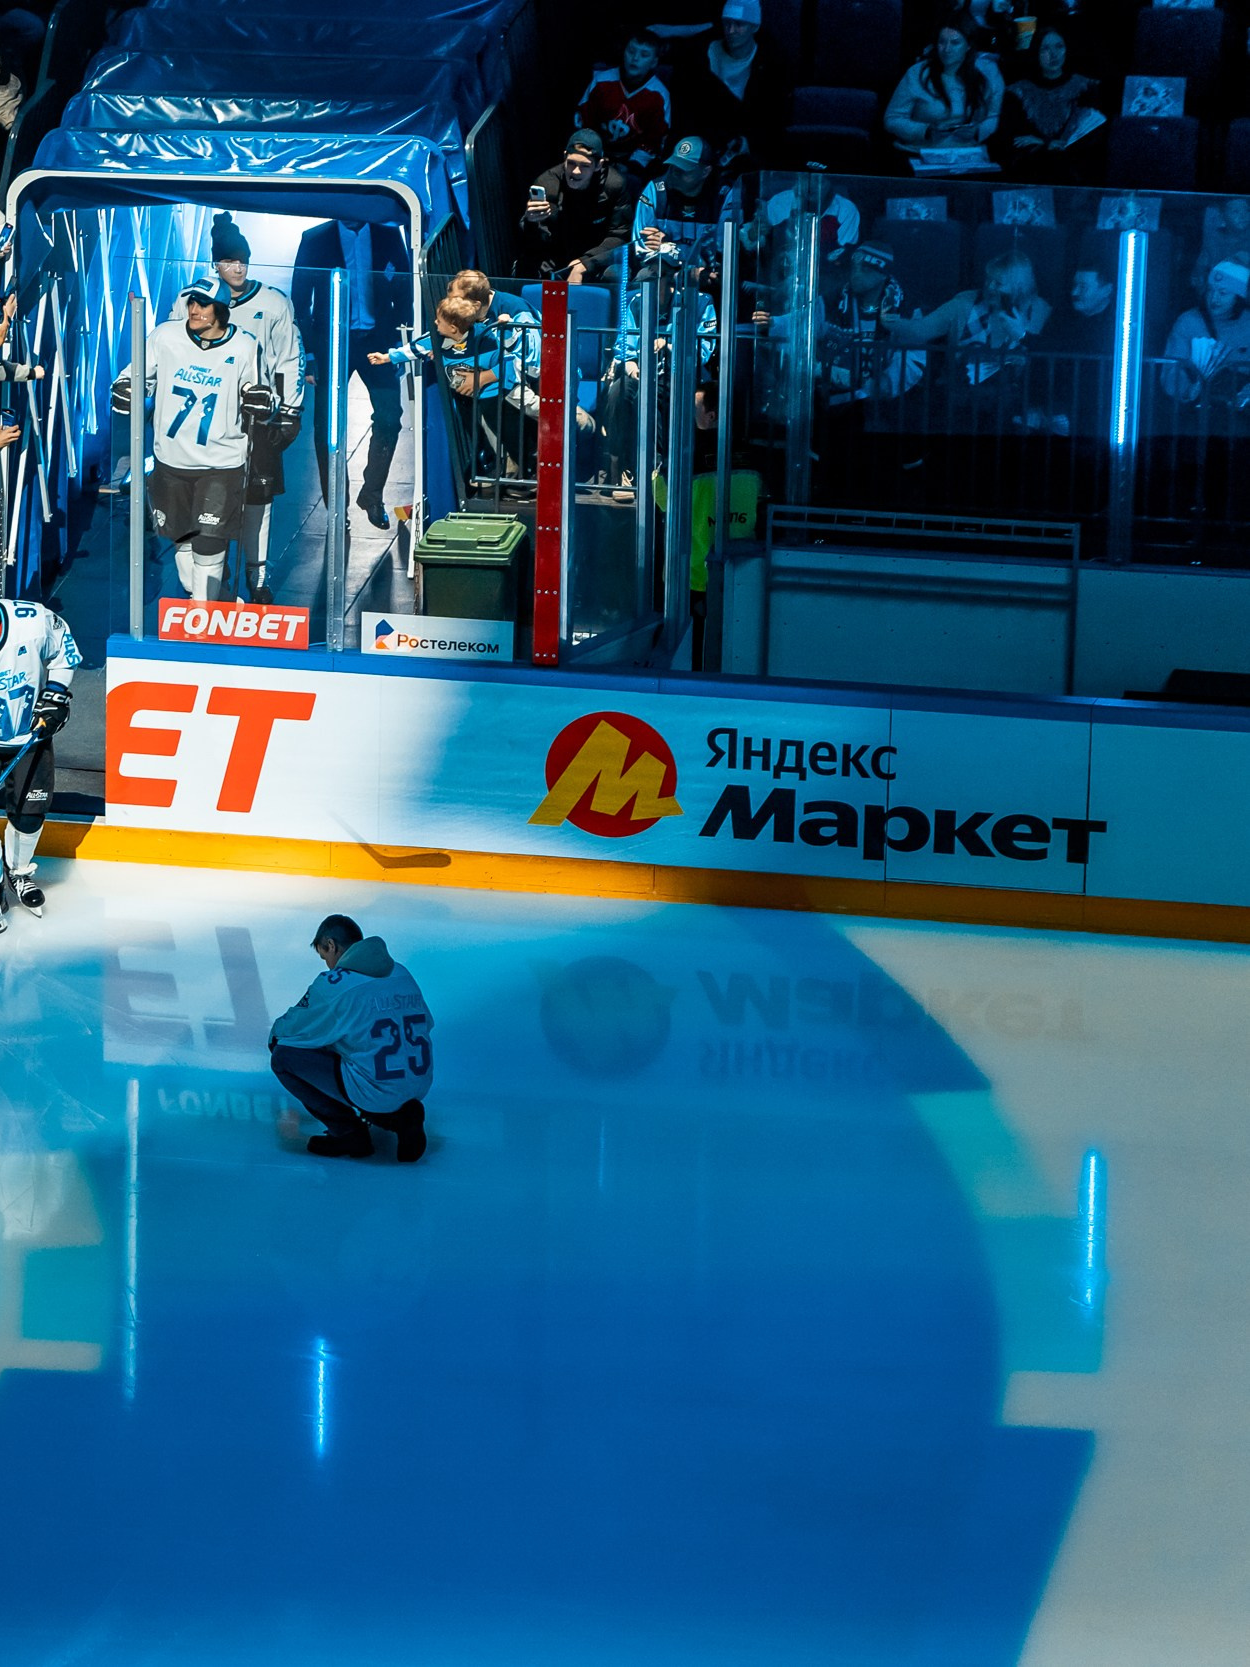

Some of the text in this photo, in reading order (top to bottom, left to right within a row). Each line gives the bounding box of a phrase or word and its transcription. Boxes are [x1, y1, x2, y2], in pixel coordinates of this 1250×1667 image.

[166, 385, 219, 447] 71
[161, 606, 306, 641] FONBET
[396, 633, 500, 655] Ростелеком
[705, 727, 898, 782] Яндекс
[698, 784, 1108, 865] Маркет
[370, 1013, 431, 1081] 25
